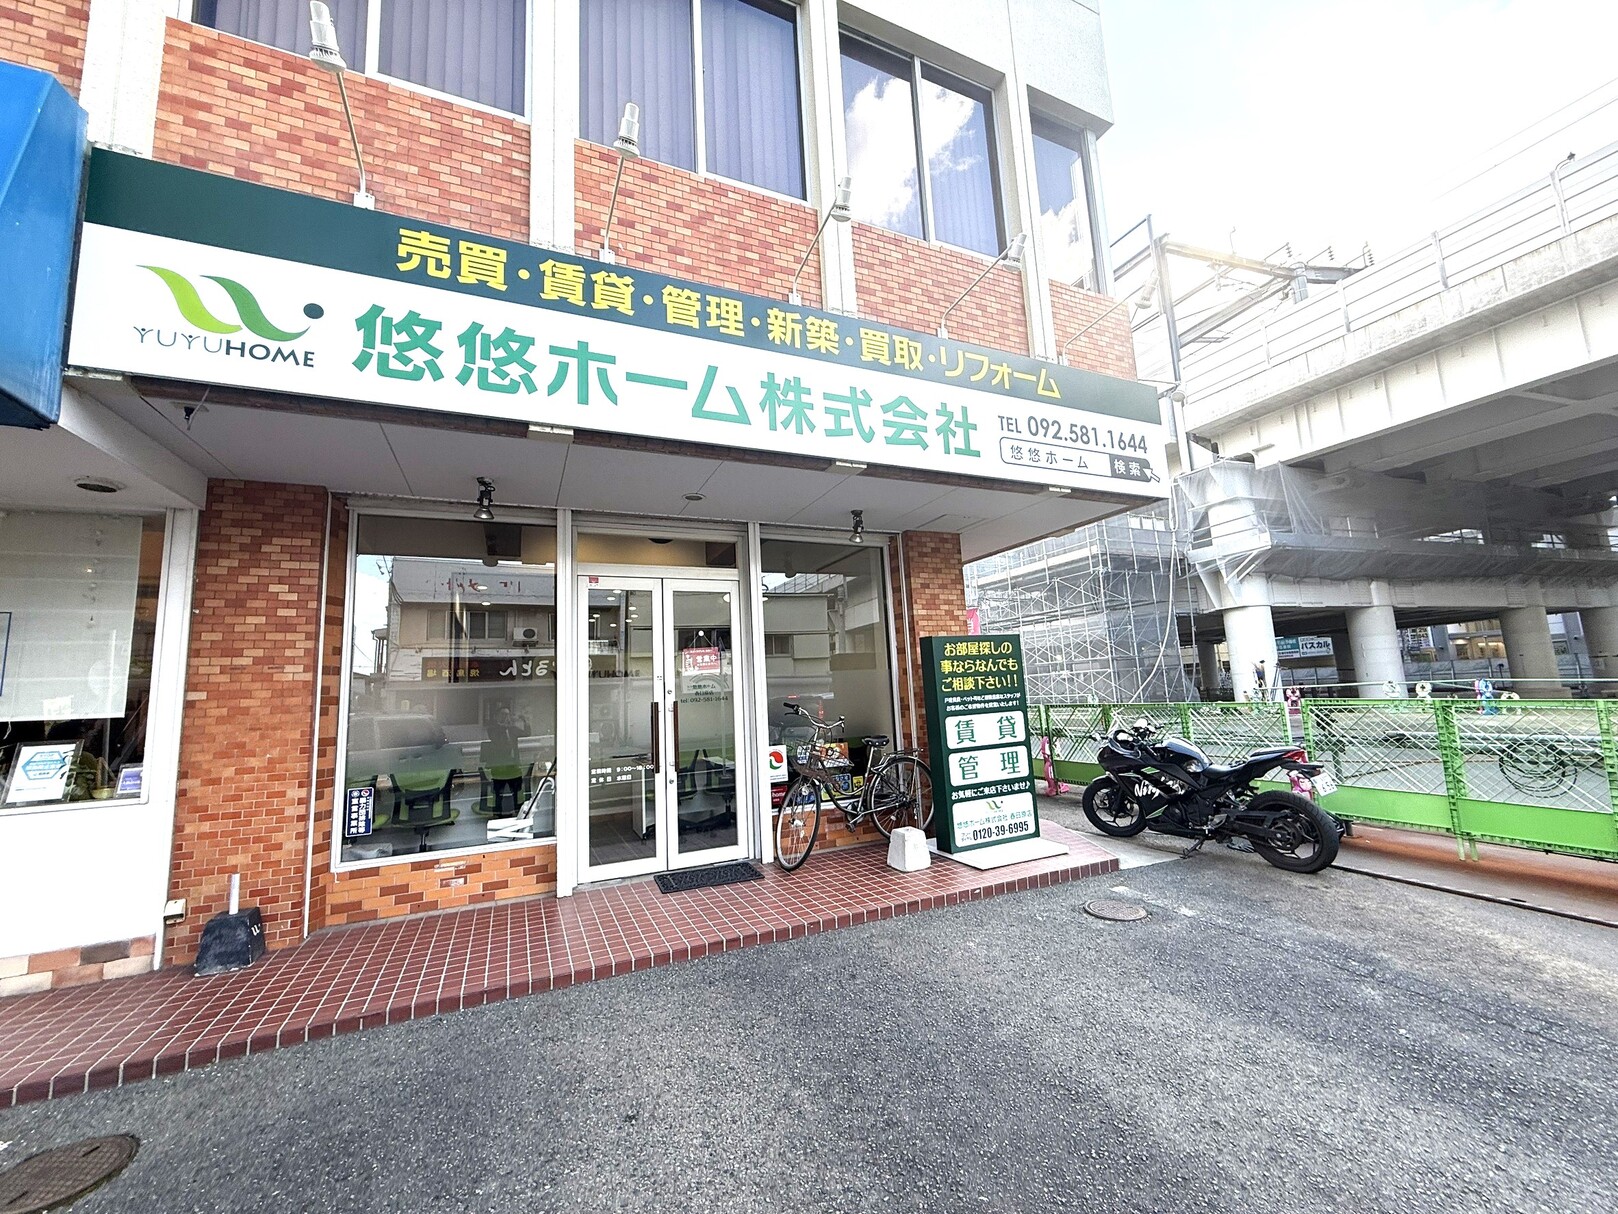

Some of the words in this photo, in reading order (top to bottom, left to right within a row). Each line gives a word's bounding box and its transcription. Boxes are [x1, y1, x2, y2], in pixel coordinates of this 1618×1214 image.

[396, 228, 1062, 400] 売買・賃貸・管理・新築・買取・リフォーム
[133, 326, 315, 368] YUYUHOME
[352, 303, 982, 458] 悠悠ホーム株式会社
[998, 415, 1022, 434] TEL
[1027, 416, 1147, 454] 092.581.1644
[1010, 444, 1088, 469] 悠悠ホーム
[1113, 459, 1141, 477] 検索
[940, 658, 1018, 674] 事ならなんでも
[944, 641, 1012, 657] お部屋探しの
[973, 821, 1029, 841] 0120-39-6995
